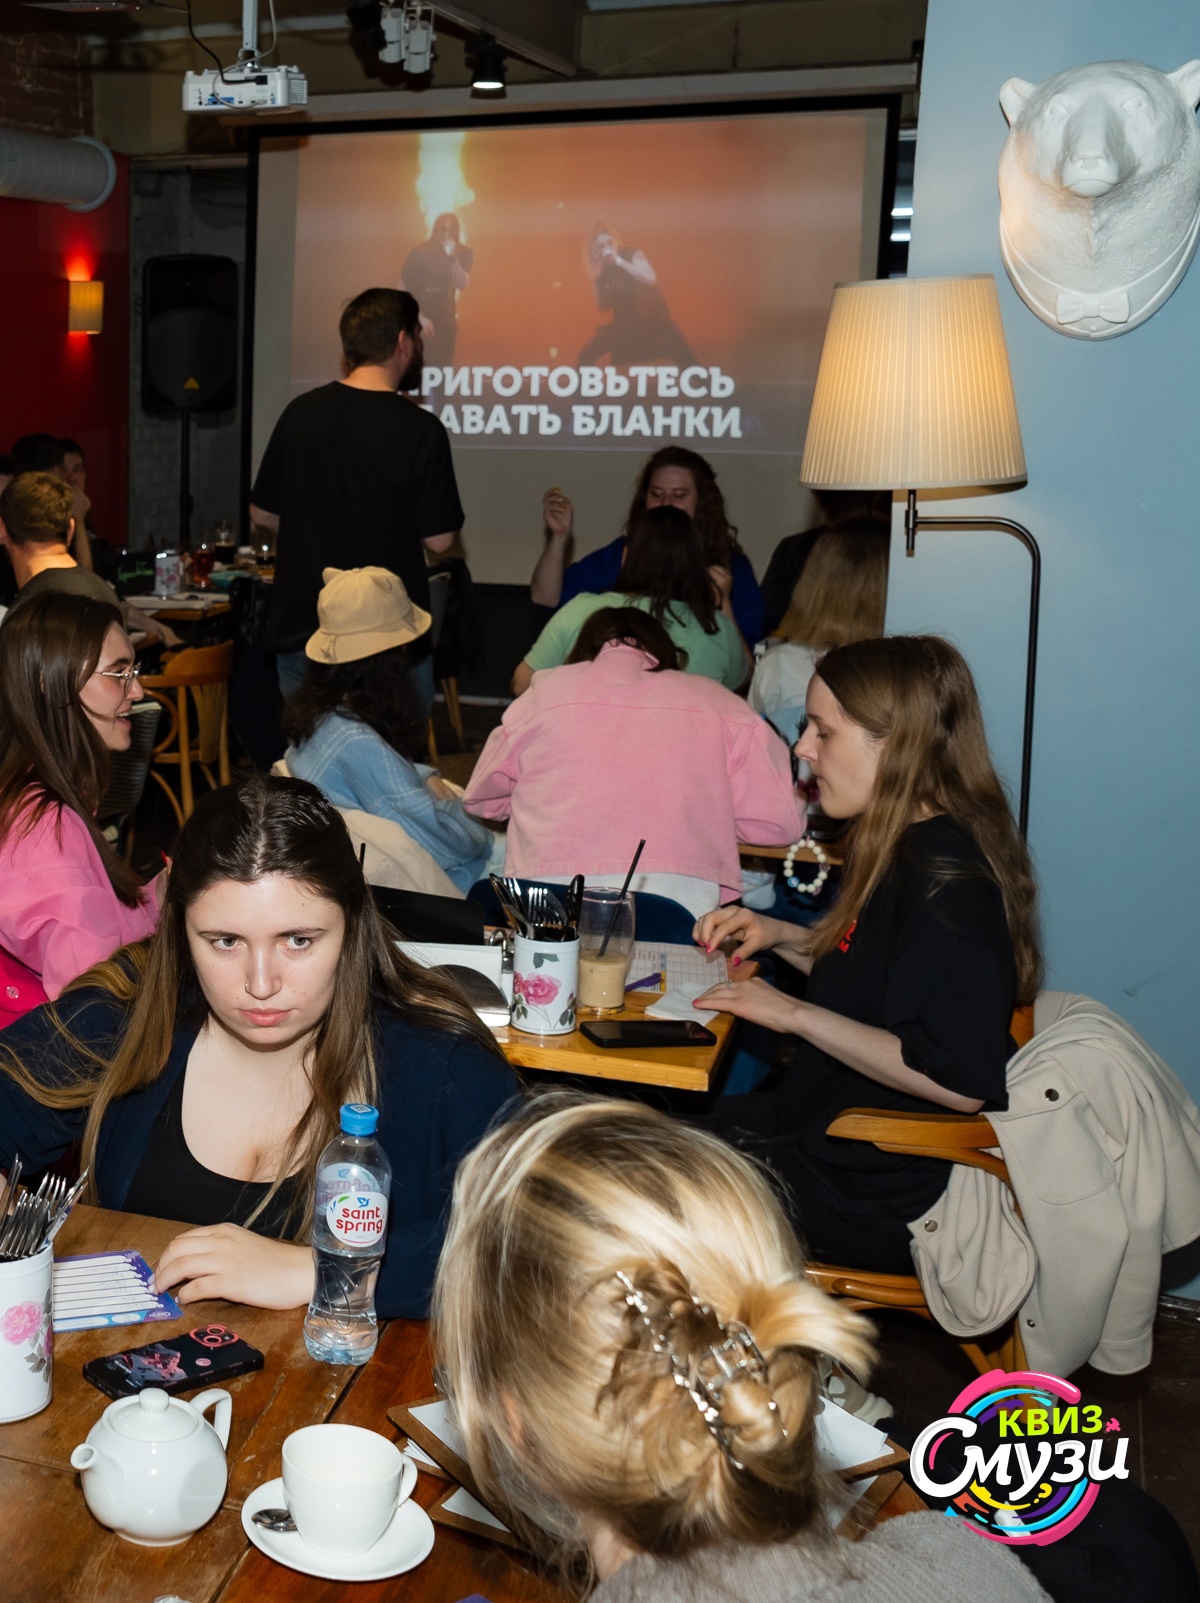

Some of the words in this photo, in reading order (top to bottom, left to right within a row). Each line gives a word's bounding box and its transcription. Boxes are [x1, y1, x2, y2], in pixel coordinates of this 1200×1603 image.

[397, 366, 735, 398] РИГОТОВЬТЕСЬ
[418, 404, 562, 436] АВАТЬ
[572, 406, 742, 439] БЛАНКИ
[342, 1206, 381, 1220] saint
[336, 1218, 383, 1235] spring
